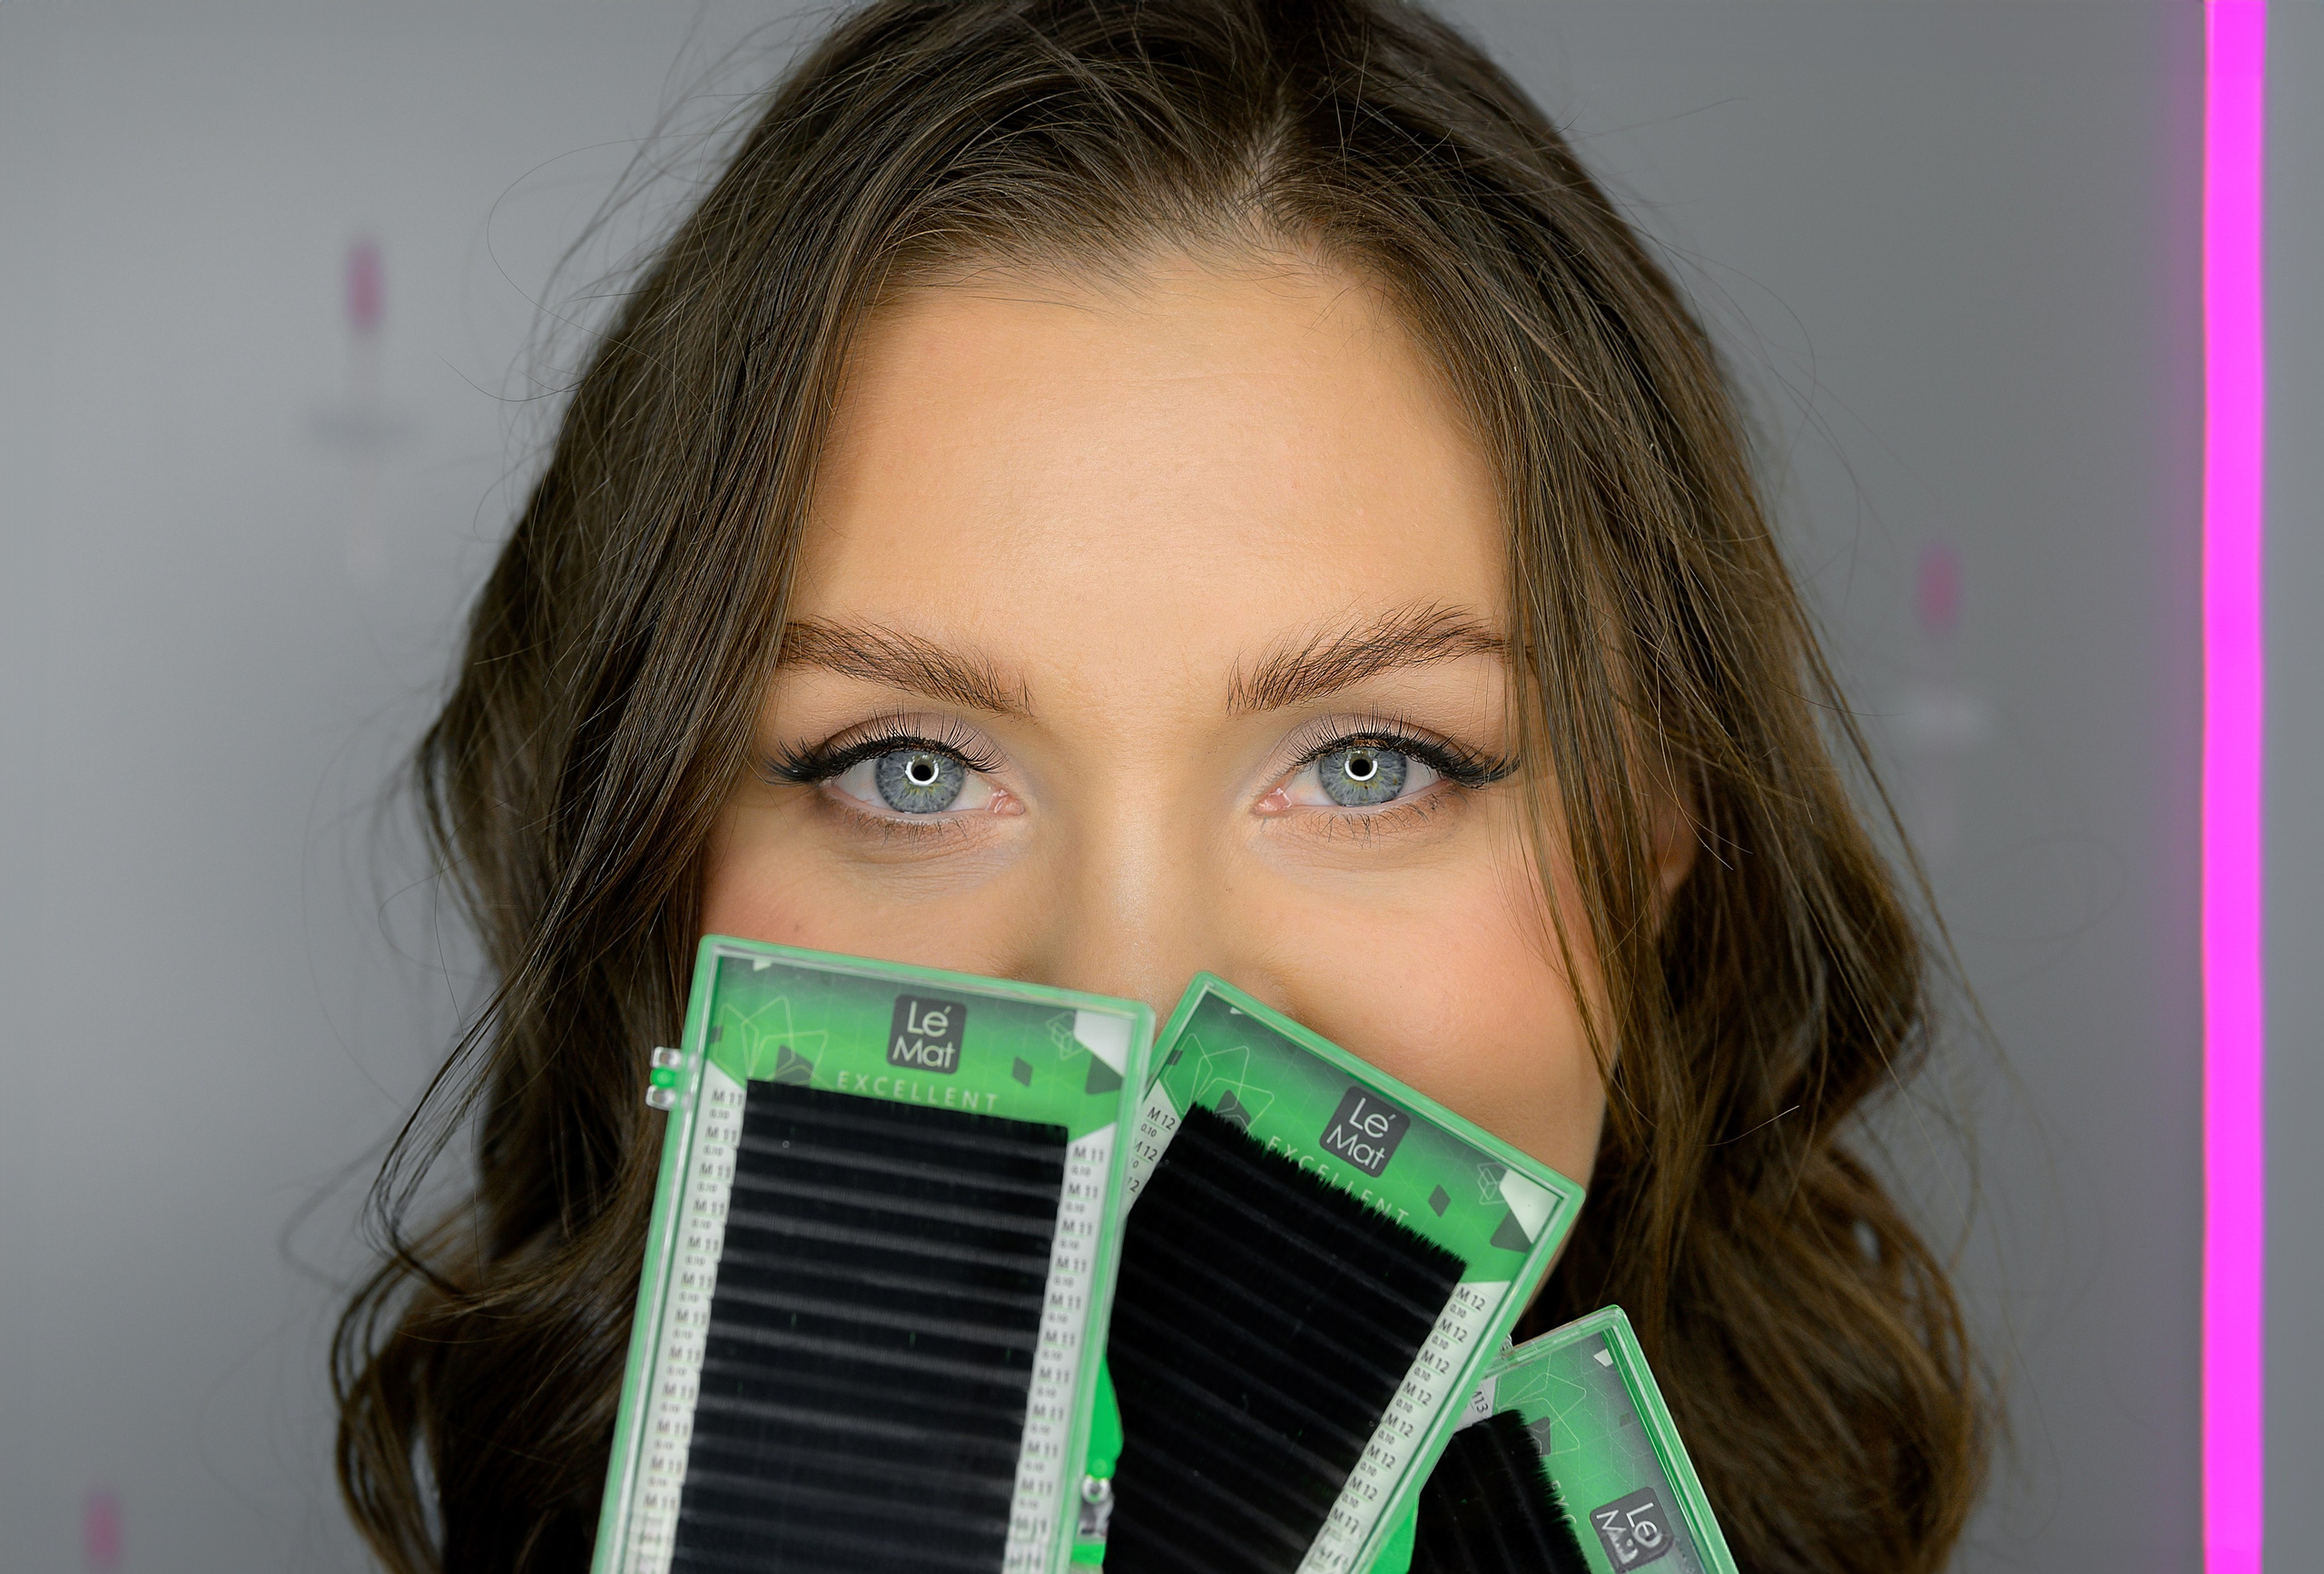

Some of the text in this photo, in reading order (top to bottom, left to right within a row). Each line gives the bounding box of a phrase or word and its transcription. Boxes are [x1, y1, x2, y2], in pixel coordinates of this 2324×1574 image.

[907, 1000, 952, 1038] Lé
[891, 1035, 956, 1069] Mat
[712, 1089, 724, 1103] M
[837, 1070, 999, 1112] EXCELLENT
[1147, 1106, 1175, 1130] M 12
[1349, 1097, 1396, 1138] Lé
[1140, 1124, 1157, 1138] 0.10
[1073, 1146, 1086, 1158] M
[1144, 1146, 1157, 1162] 12
[1326, 1124, 1385, 1169] Mat
[1456, 1285, 1485, 1311] M 12
[1438, 1317, 1468, 1343] M 12
[1420, 1349, 1450, 1374] M 12
[1402, 1381, 1432, 1405] M 12
[1384, 1412, 1413, 1437] M 12
[1366, 1443, 1395, 1469] M 12
[1348, 1475, 1377, 1500] M 12
